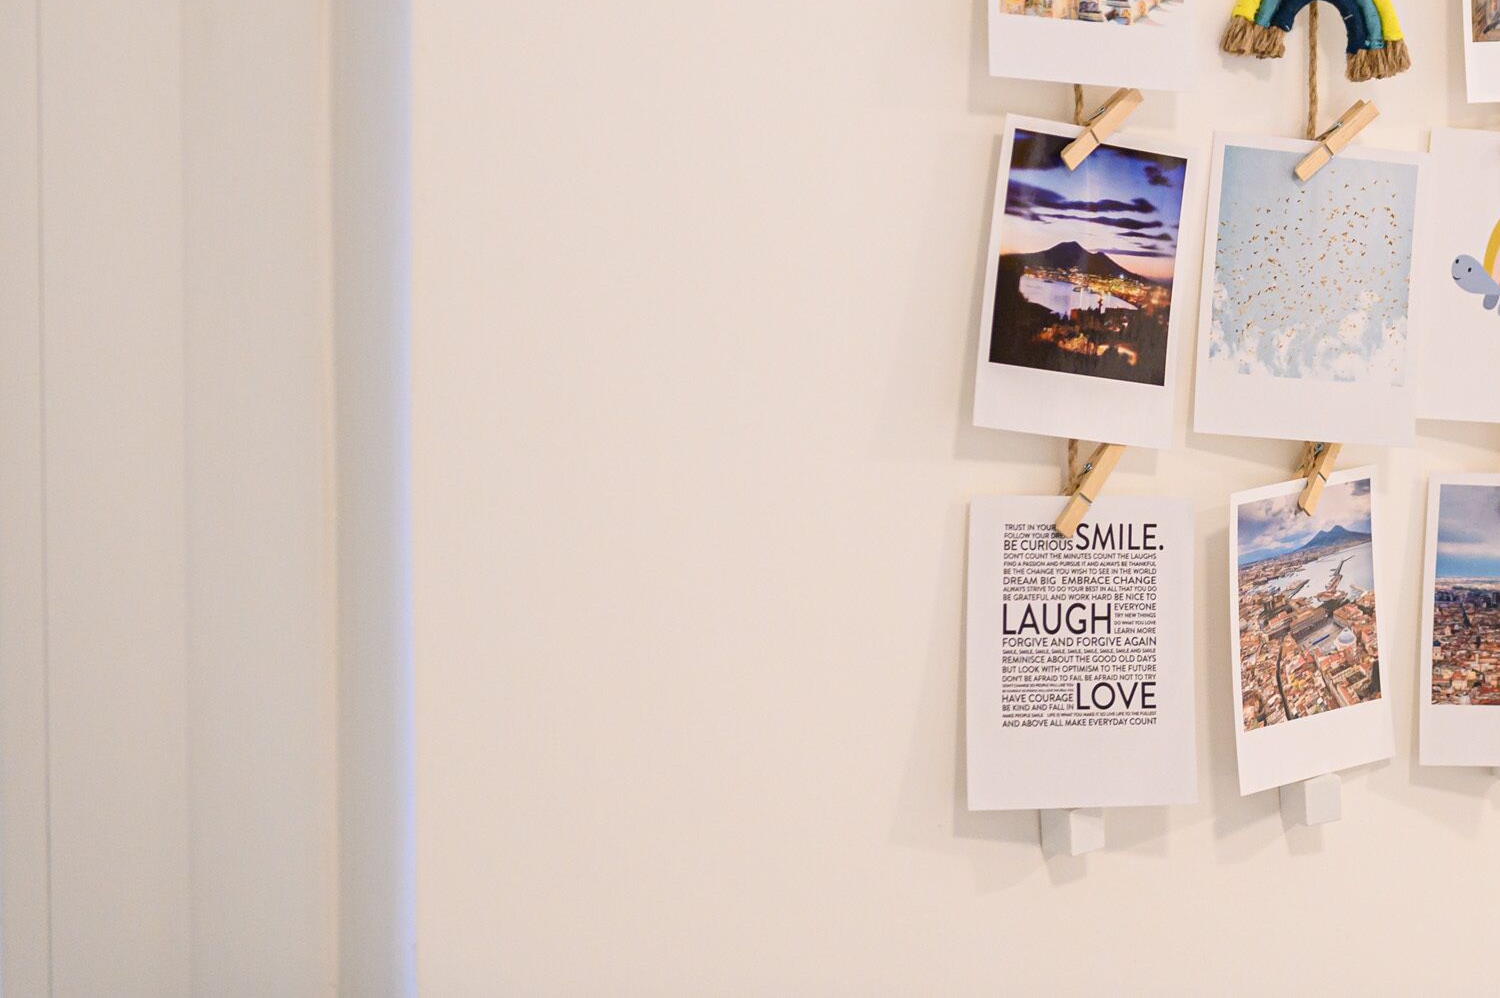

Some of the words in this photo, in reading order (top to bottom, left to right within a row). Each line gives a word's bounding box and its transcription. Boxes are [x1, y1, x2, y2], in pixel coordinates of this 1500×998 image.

[1076, 523, 1164, 551] SMILE.
[1004, 540, 1018, 551] BE
[1020, 540, 1073, 551] CURIOUS
[1003, 576, 1038, 585] DREAM
[1040, 576, 1057, 585] BIG
[1062, 576, 1110, 585] EMBRACE
[1113, 576, 1156, 585] CHANGE
[1013, 593, 1049, 601] GRATEFUL
[1050, 593, 1066, 601] AND
[1068, 593, 1090, 601] WORK
[1092, 593, 1112, 601] HARD
[1114, 593, 1124, 601] BE
[1126, 593, 1144, 601] NICE
[1146, 593, 1156, 601] TO
[1002, 603, 1110, 635] LAUGH
[1002, 637, 1048, 647] FORGIVE
[1050, 637, 1074, 647] AND
[1076, 637, 1122, 647] FORGIVE
[1124, 637, 1156, 646] AGAIN
[1047, 655, 1074, 663] ABOUT
[1075, 655, 1090, 663] THE
[1092, 655, 1117, 663] GOOD
[1119, 655, 1135, 663] OLD
[1137, 655, 1156, 663] DAYS
[1002, 666, 1016, 674] BUT
[1041, 665, 1060, 673] WITH
[1062, 665, 1099, 673] OPTIMISM
[1100, 665, 1111, 673] TO
[1128, 664, 1156, 672] FUTURE
[1070, 674, 1083, 682] FAIL
[1002, 694, 1026, 703] HAVE
[1028, 693, 1073, 702] COURAGE
[1077, 682, 1156, 710] LOVE
[1002, 704, 1011, 712] BE
[1002, 719, 1020, 728] AND
[1022, 719, 1048, 727] ABOVE
[1050, 719, 1063, 727] ALL
[1065, 718, 1087, 726] MAKE
[1088, 718, 1128, 726] EVERYDAY
[1129, 717, 1156, 725] COUNT
